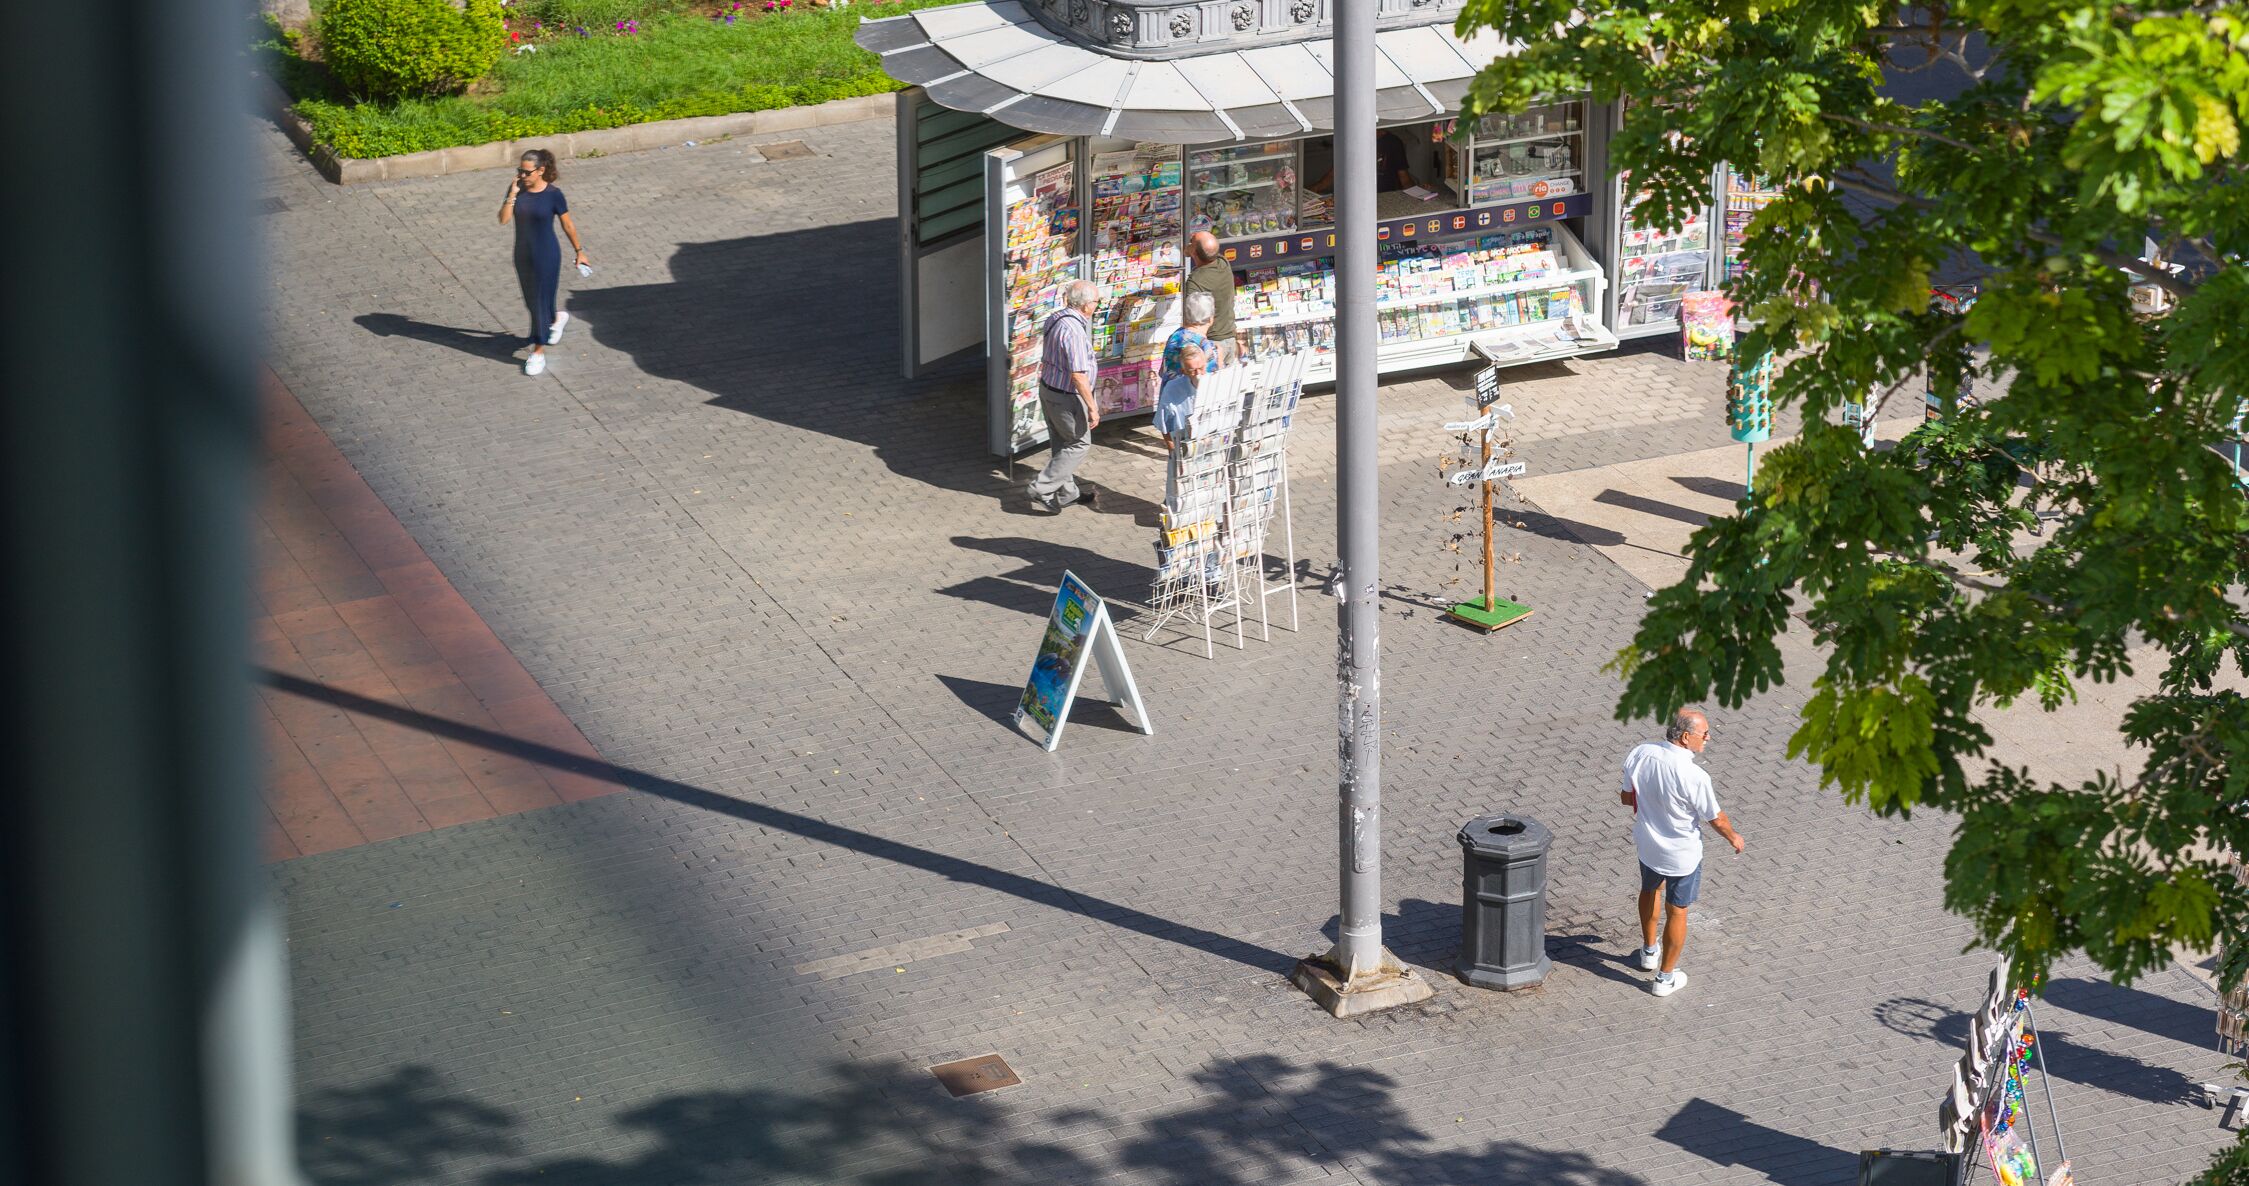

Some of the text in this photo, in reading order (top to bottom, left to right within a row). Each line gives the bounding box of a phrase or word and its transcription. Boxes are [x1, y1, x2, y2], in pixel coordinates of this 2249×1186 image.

[1536, 183, 1547, 192] ria
[1550, 180, 1570, 188] CHANGE
[1457, 465, 1523, 483] GRAN ANARIA
